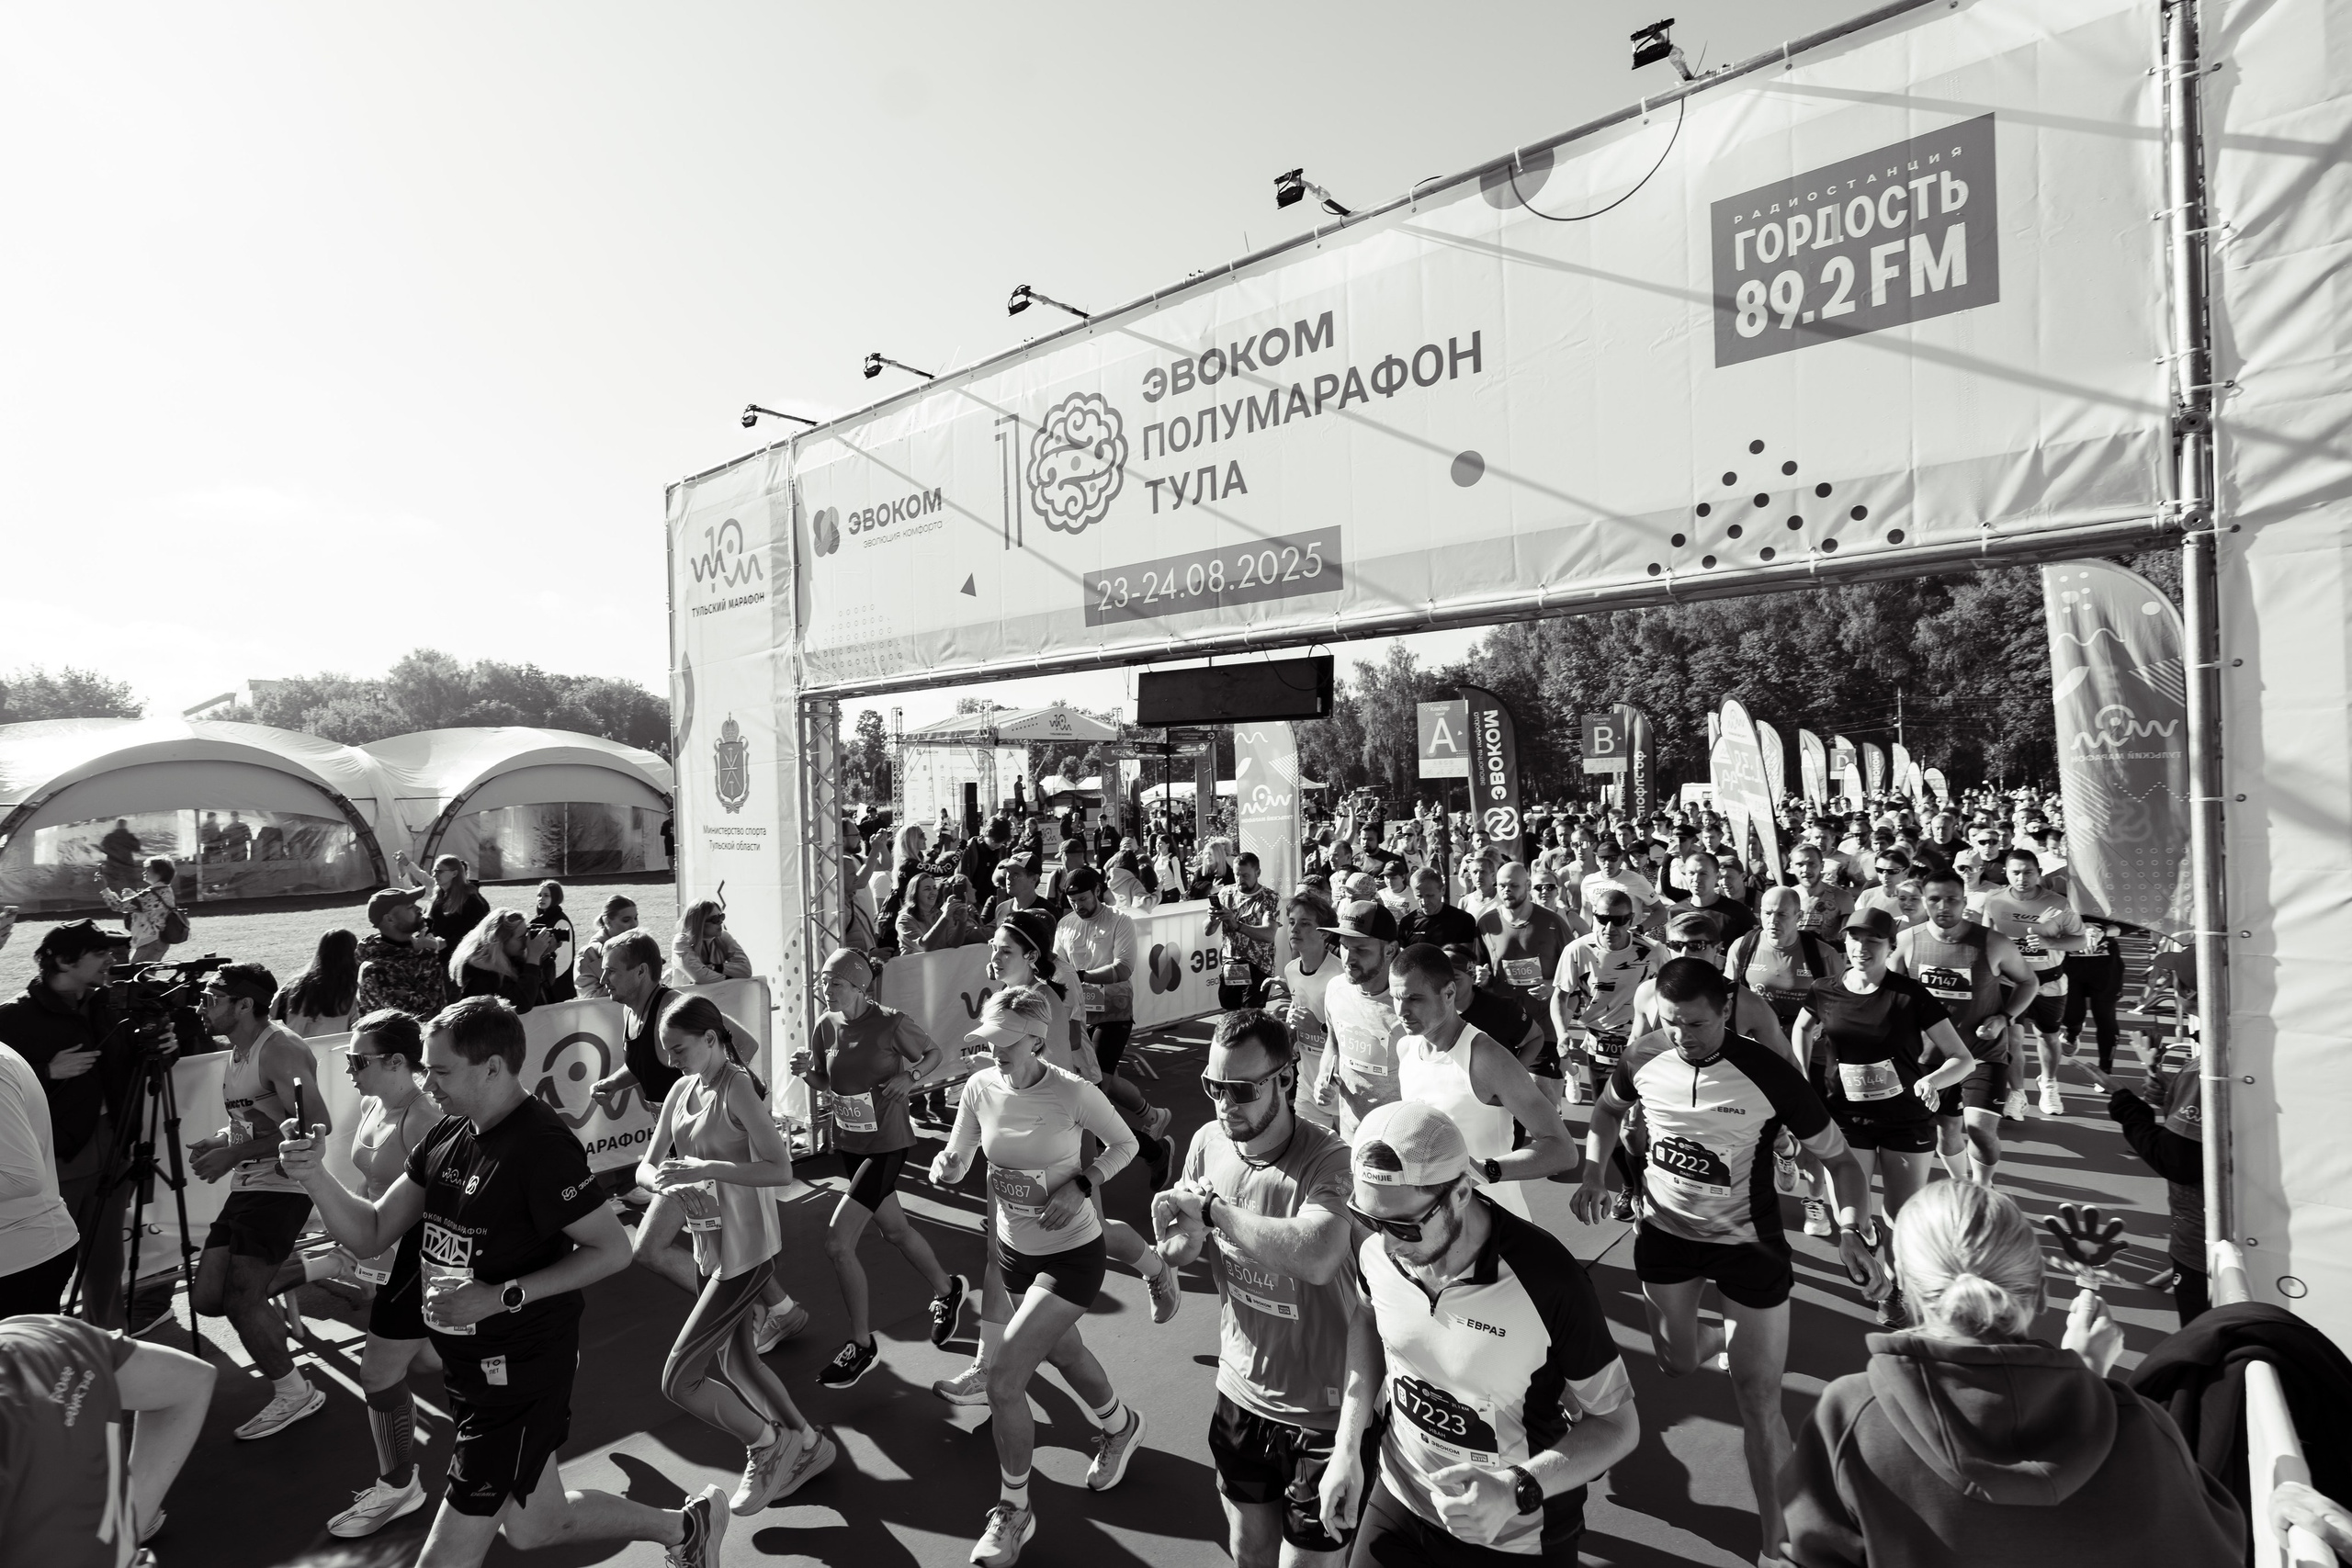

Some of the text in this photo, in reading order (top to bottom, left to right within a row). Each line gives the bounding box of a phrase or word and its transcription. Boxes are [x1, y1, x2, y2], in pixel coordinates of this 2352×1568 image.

[1735, 147, 1962, 224] РАДИОСТАНЦИЯ
[1735, 170, 1969, 271] ГОРДОСТЬ
[1736, 221, 1967, 338] 89.2 FM
[1141, 310, 1334, 403] ЭВОКОМ
[1143, 330, 1482, 461] ПОЛУМАРАФОН
[1145, 459, 1248, 513] ТУЛА
[848, 488, 942, 536] ЭВОКОМ
[863, 520, 943, 548] эволюция комфорта
[1097, 542, 1323, 611] 23-24.08.2025
[692, 592, 764, 617] ТУЛЬСКИЙ МАРАФОН
[1429, 717, 1457, 753] A
[1594, 726, 1614, 753] B
[703, 825, 766, 837] Министерство спорта
[708, 840, 761, 851] Тульской области
[1191, 948, 1222, 973] ЭВ
[1511, 967, 1532, 976] 5106
[1930, 975, 1957, 987] 7147
[1349, 1038, 1372, 1055] 5191
[1853, 1075, 1883, 1087] 5144
[837, 1106, 862, 1118] 5016
[1717, 1106, 1746, 1115] ЕВРАЗ
[586, 1127, 656, 1155] АРАФОН
[1668, 1148, 1710, 1175] 7222
[1000, 1181, 1030, 1198] 5087
[1363, 1172, 1392, 1182] AONIJIE
[423, 1212, 441, 1223] ОКОМ
[1234, 1264, 1274, 1291] 5044
[1467, 1318, 1506, 1337] ЕВРАЗ
[487, 1359, 501, 1368] 10
[1410, 1392, 1466, 1435] 7223
[1429, 1427, 1446, 1438] ИВАН
[1431, 1440, 1460, 1455] ЭВОКОМ
